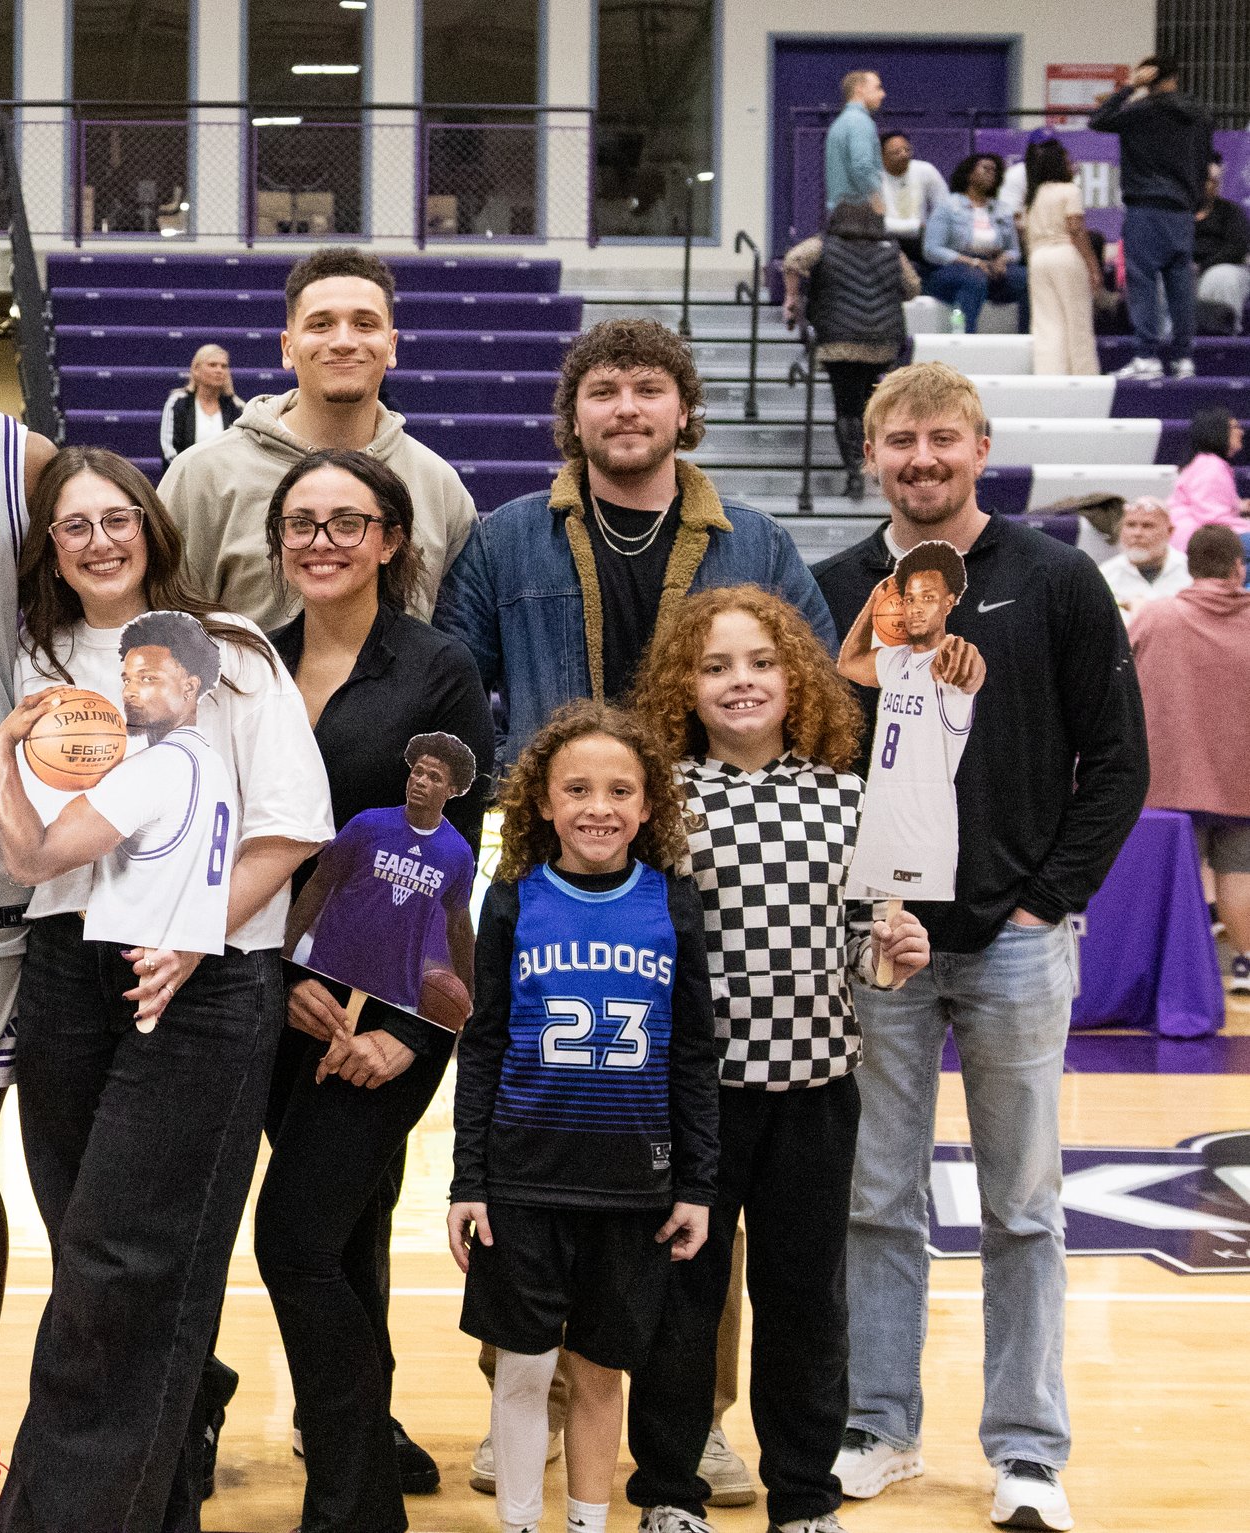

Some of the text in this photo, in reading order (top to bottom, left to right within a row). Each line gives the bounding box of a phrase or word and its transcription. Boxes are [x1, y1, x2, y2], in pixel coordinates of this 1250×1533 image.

[54, 710, 122, 729] SPALDING
[60, 742, 120, 755] LEGACY
[881, 722, 901, 770] 8
[206, 801, 230, 886] 8
[373, 849, 445, 889] EAGLES
[373, 868, 435, 898] BASKETBALL
[518, 940, 675, 987] BULLDOGS
[538, 995, 654, 1072] 23
